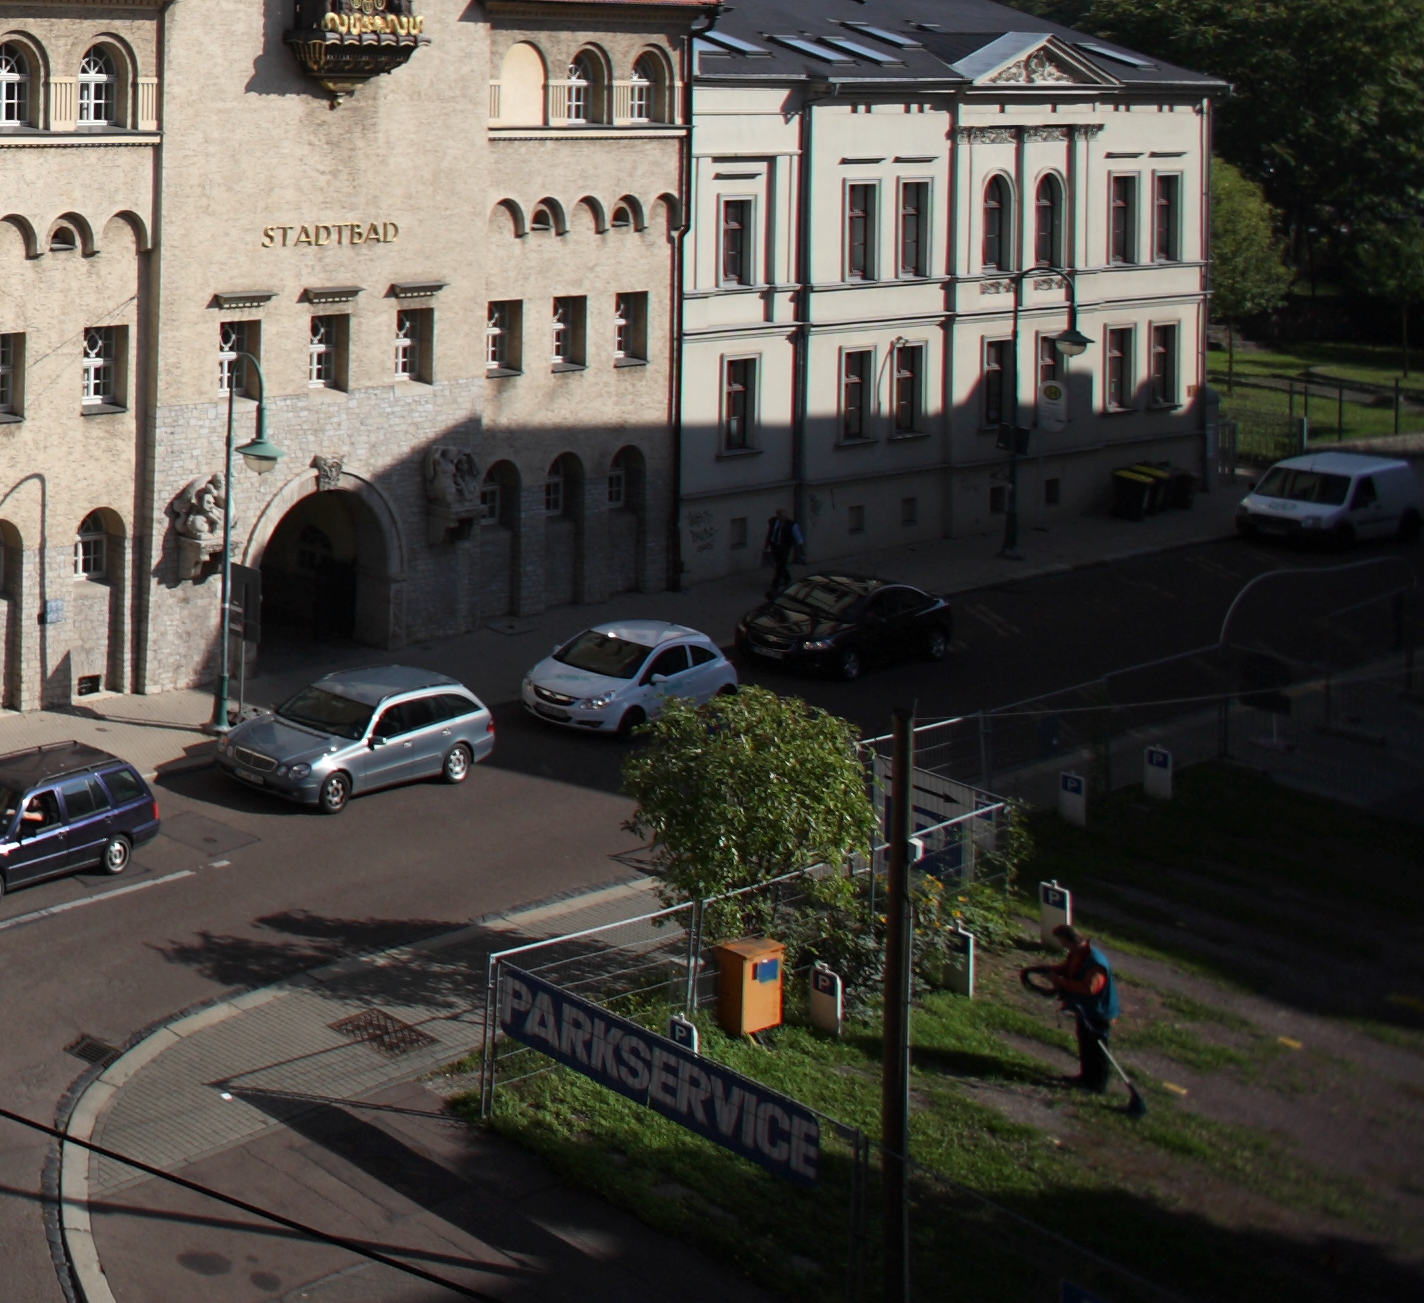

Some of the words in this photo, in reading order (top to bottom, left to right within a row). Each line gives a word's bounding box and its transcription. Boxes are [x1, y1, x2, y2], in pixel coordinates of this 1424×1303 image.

[261, 221, 399, 248] STADTBAD
[1067, 778, 1077, 792] P
[1048, 891, 1061, 904] P
[817, 975, 831, 990] P
[675, 1025, 687, 1041] P
[501, 973, 821, 1181] PARKSERVICE
